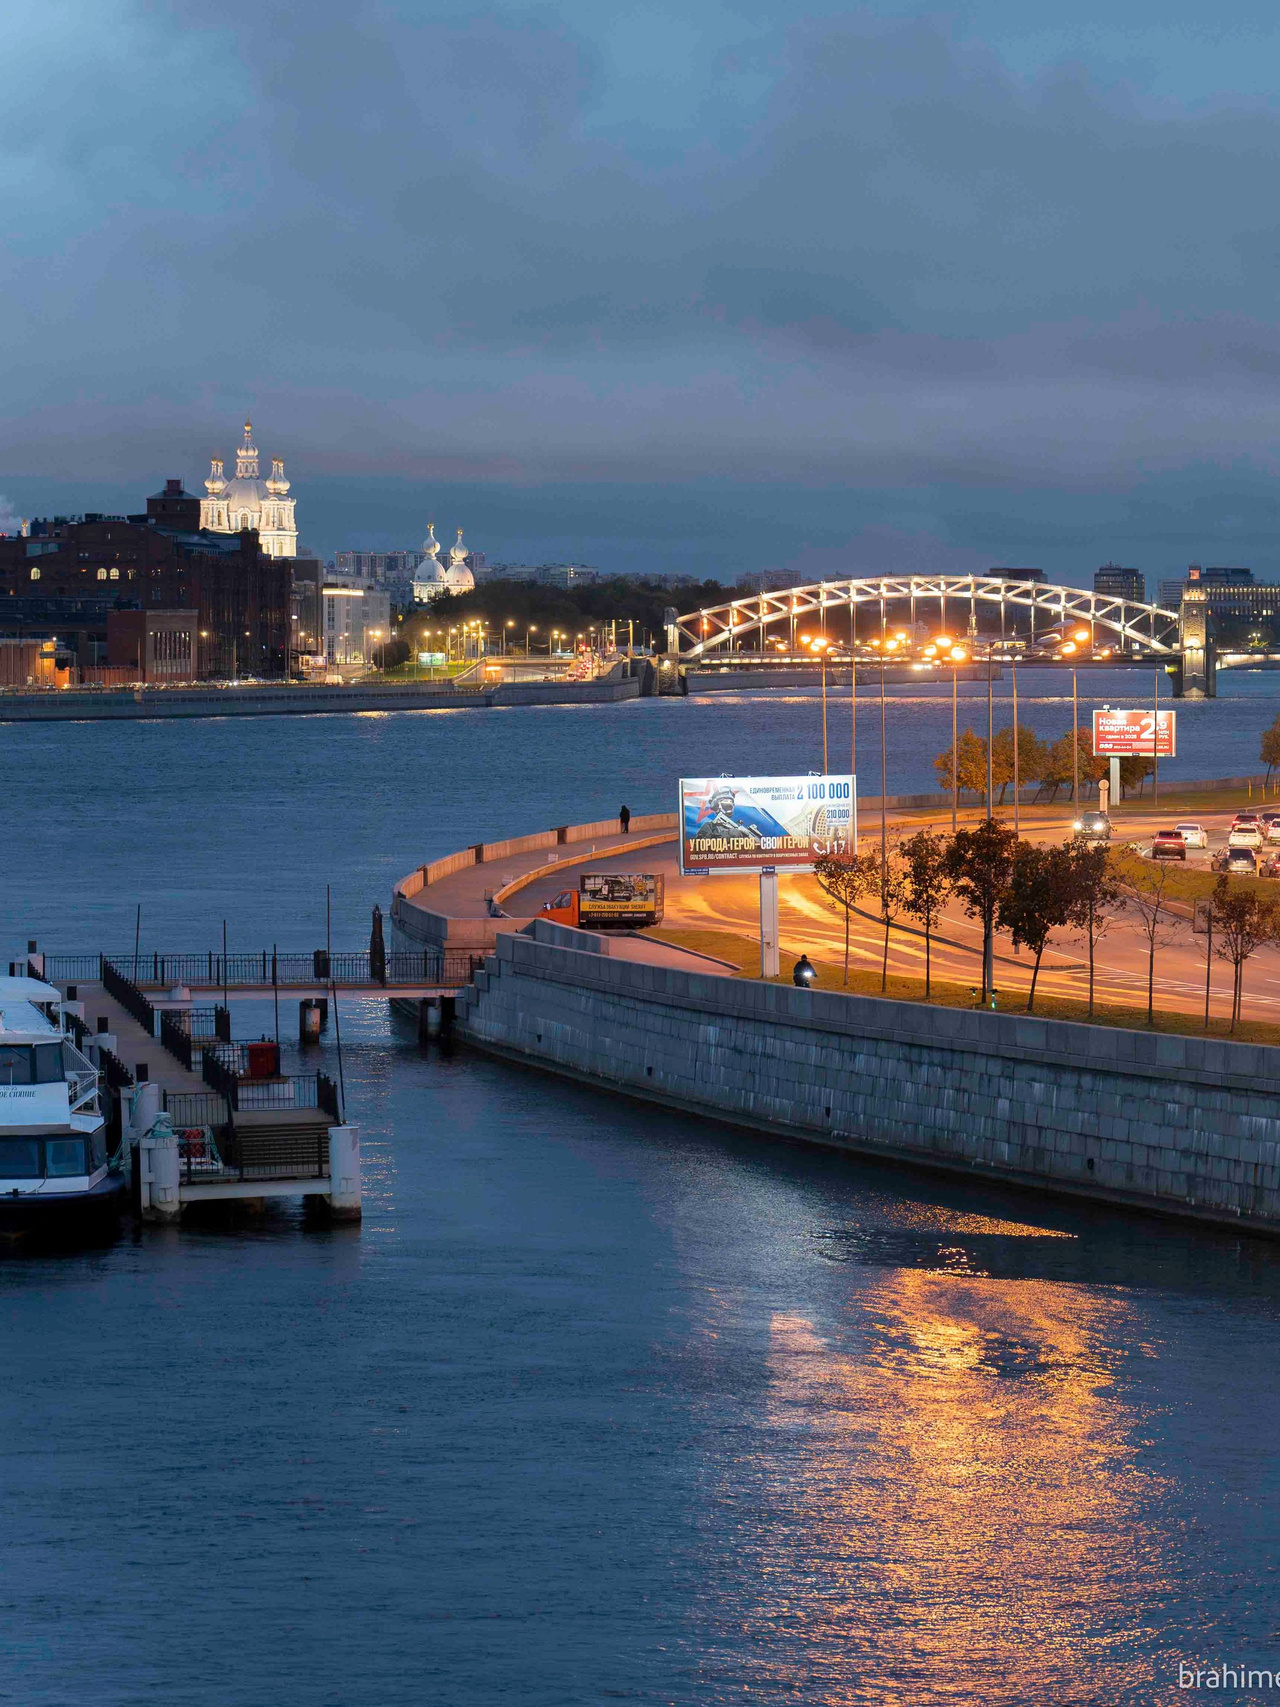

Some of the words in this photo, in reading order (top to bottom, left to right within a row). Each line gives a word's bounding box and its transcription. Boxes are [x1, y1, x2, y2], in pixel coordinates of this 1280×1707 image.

[750, 786, 795, 794] ЕДИНОВРЕМЕННАЯ
[797, 784, 804, 800] 2
[807, 783, 826, 800] 100
[828, 782, 850, 799] 000
[771, 793, 795, 801] ВЫПЛАТА
[826, 809, 837, 819] 210
[837, 809, 850, 819] 000
[689, 838, 696, 852] У
[760, 836, 783, 850] СВОИ
[783, 835, 809, 849] ГЕРОИ
[825, 840, 846, 855] 117
